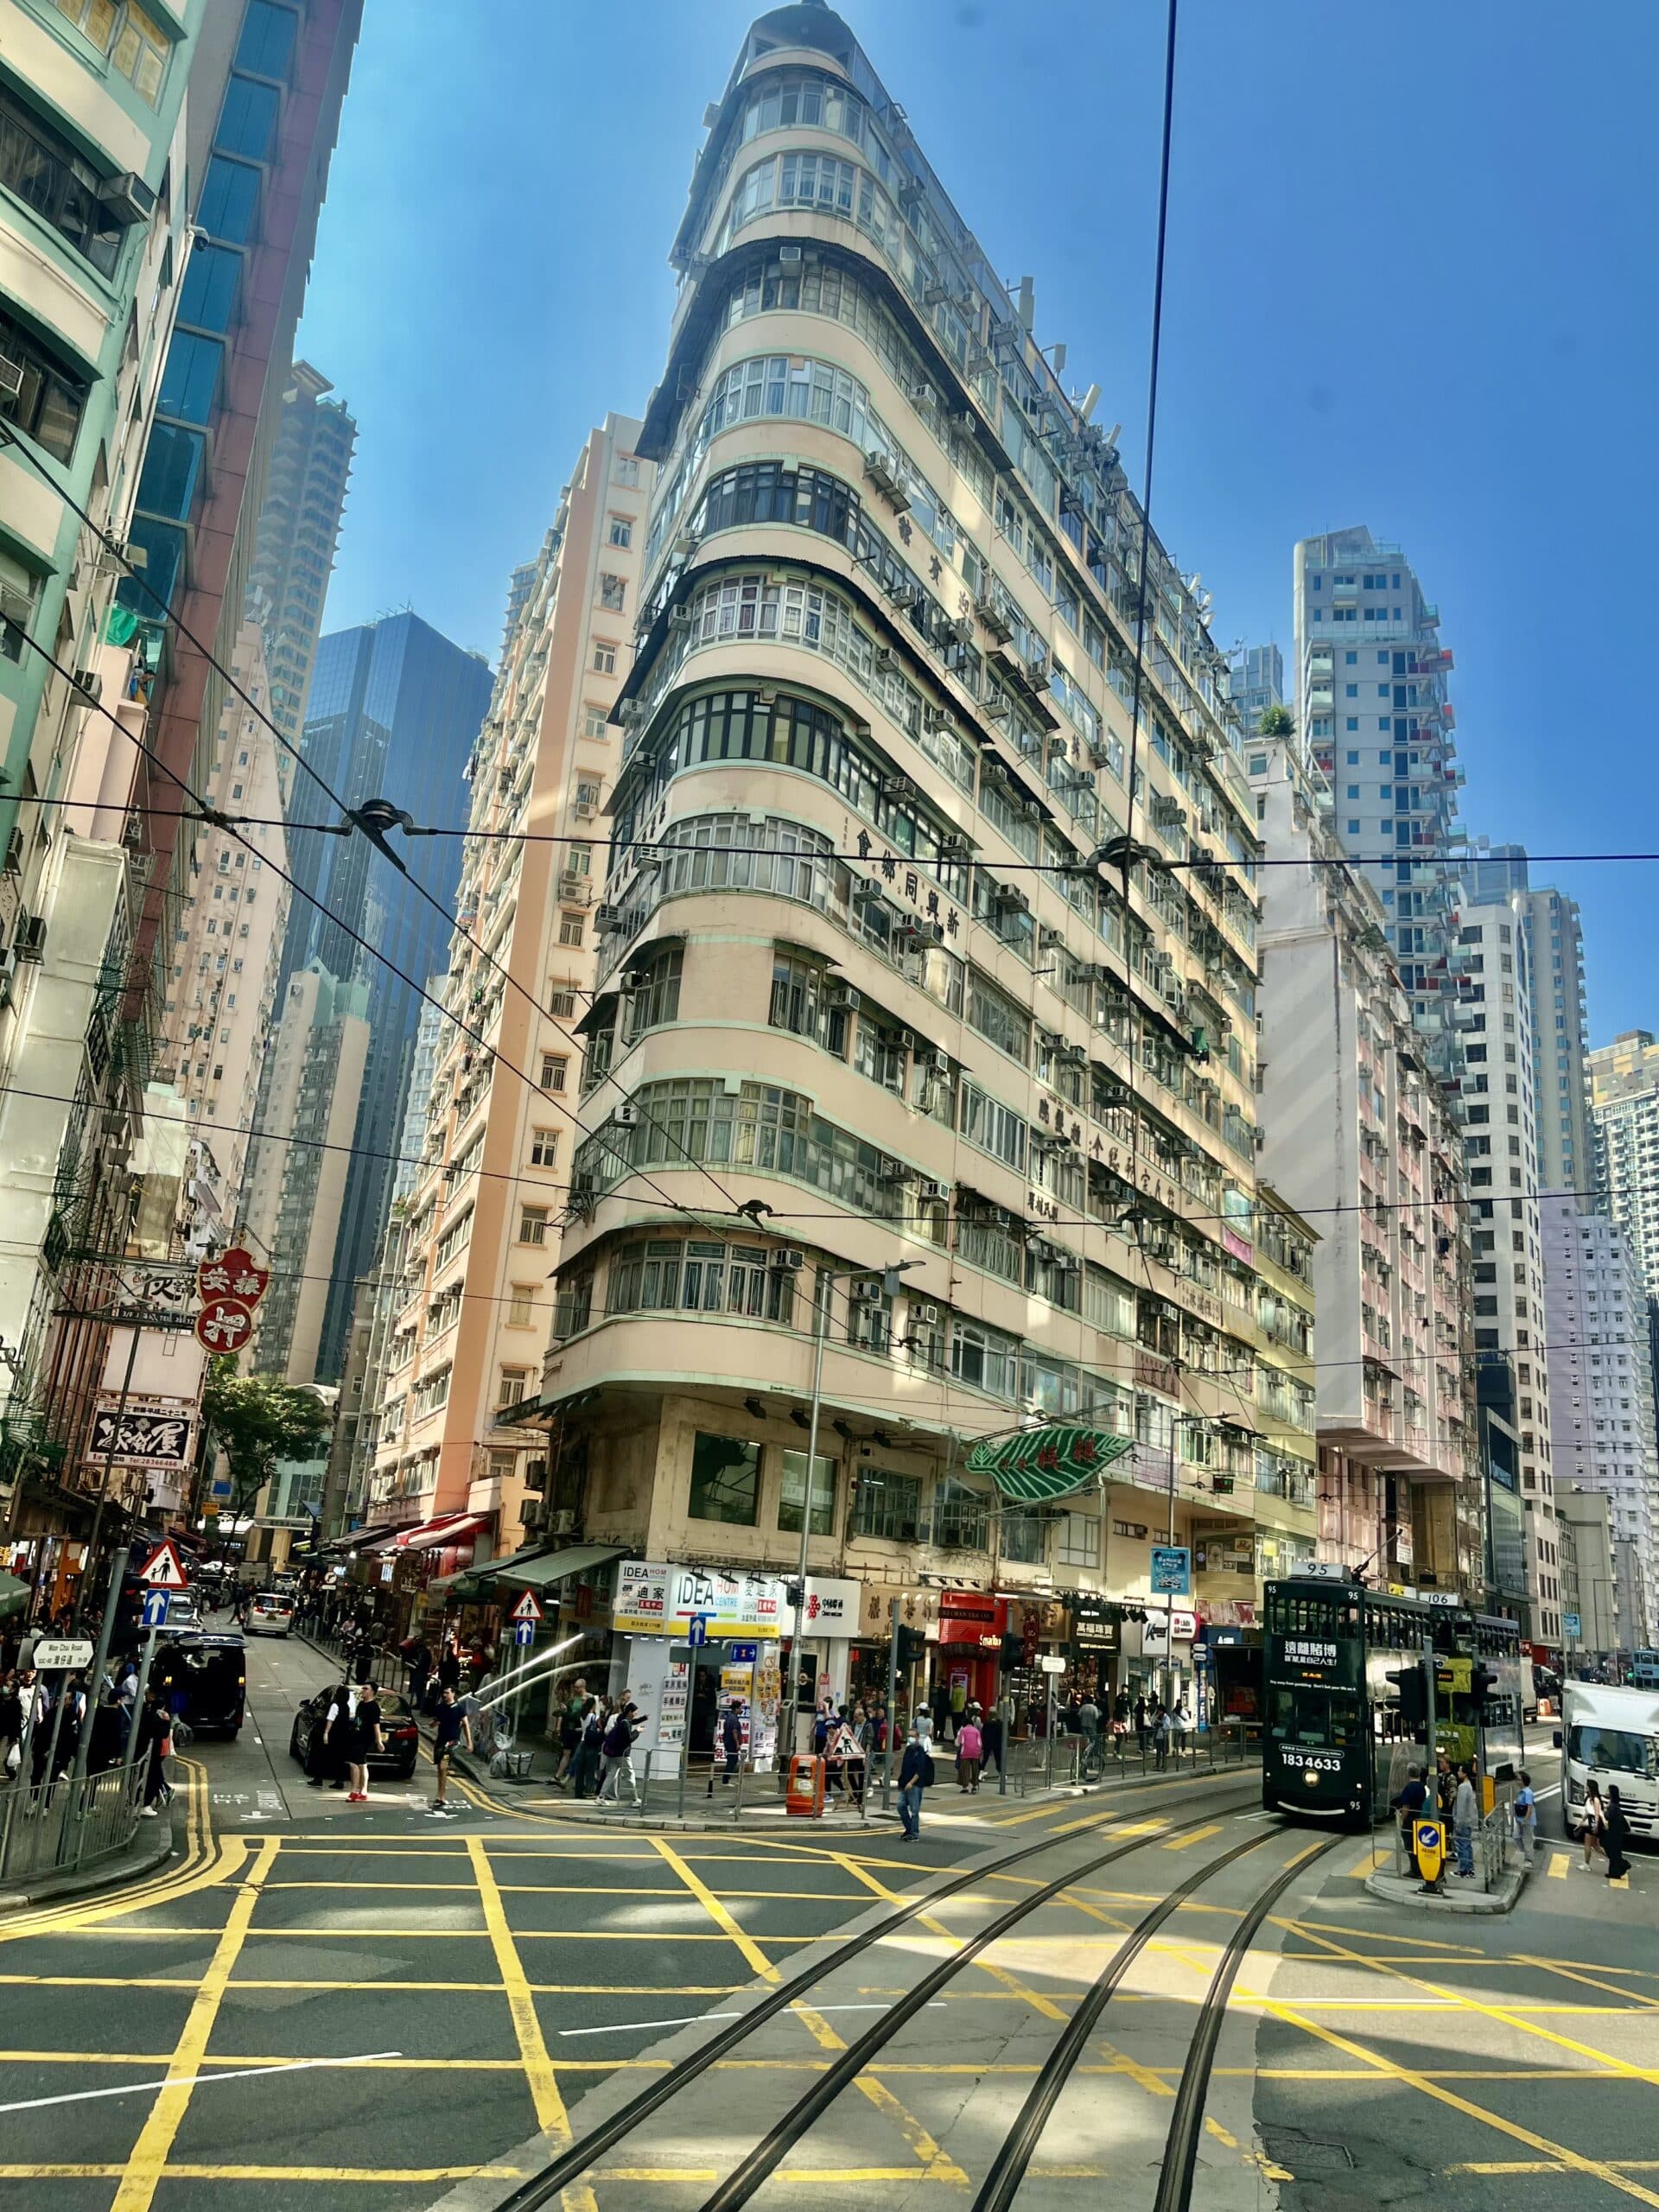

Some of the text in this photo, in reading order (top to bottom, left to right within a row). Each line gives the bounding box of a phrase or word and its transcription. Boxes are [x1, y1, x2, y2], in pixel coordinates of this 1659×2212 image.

[623, 1566, 648, 1578] IDEA
[1307, 1563, 1329, 1576] 95
[677, 1575, 715, 1606] IDEA
[1268, 1585, 1277, 1594] 95
[1348, 1591, 1359, 1600] 95
[1427, 1594, 1449, 1605] 106
[1281, 1753, 1341, 1771] 1834633
[1350, 1801, 1361, 1810] 95
